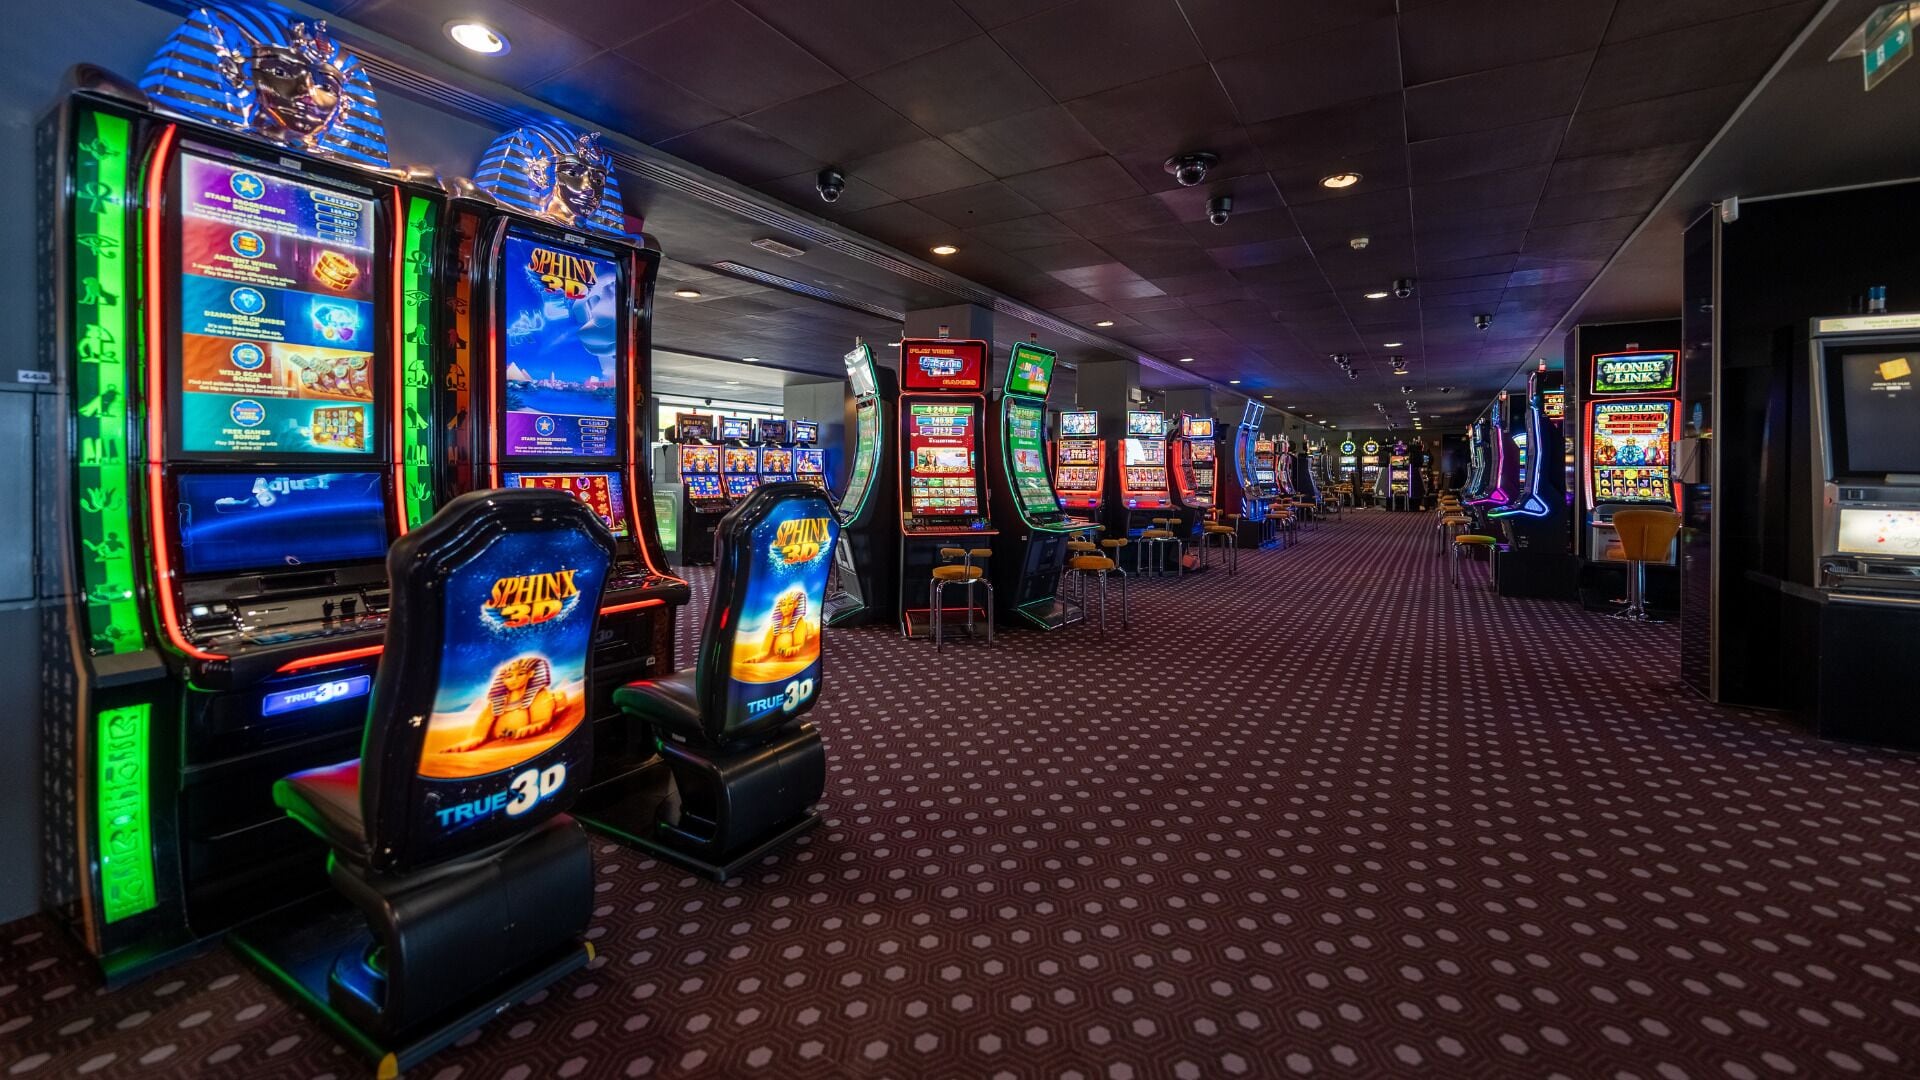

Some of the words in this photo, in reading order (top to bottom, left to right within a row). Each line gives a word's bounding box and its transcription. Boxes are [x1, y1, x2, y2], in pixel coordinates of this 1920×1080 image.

[528, 247, 598, 285] SPHINX
[541, 274, 589, 300] 3D
[1606, 361, 1662, 373] MONEY
[1614, 372, 1654, 384] LINK
[1601, 404, 1638, 412] MONEY
[772, 518, 832, 547] SPHINX
[781, 543, 820, 564] 3D
[485, 569, 580, 608] SPHINX
[501, 600, 564, 628] 3D
[782, 678, 814, 712] 3D
[504, 762, 567, 817] 3D
